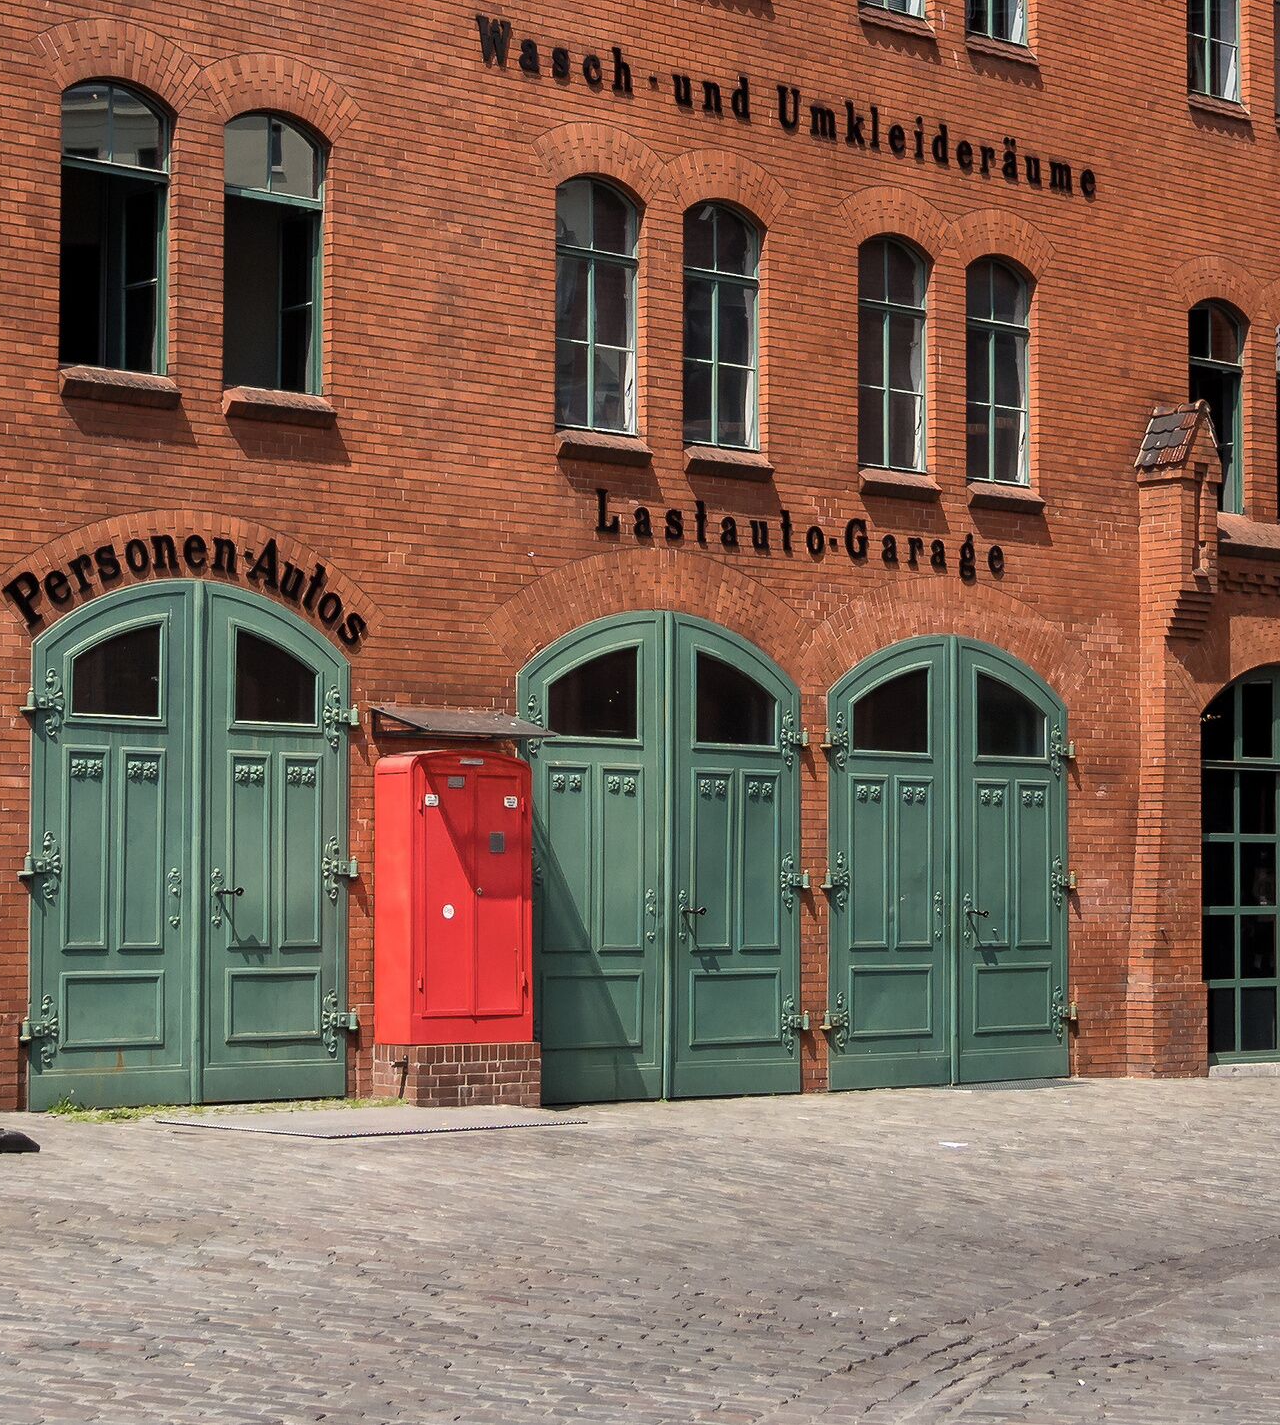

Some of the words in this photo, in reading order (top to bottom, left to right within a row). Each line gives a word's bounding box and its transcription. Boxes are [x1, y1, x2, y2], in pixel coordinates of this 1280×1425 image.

[776, 84, 1096, 200] Umkleideräume
[2, 533, 368, 647] Personen-Autos
[595, 487, 1005, 584] Lastauto-Garage
